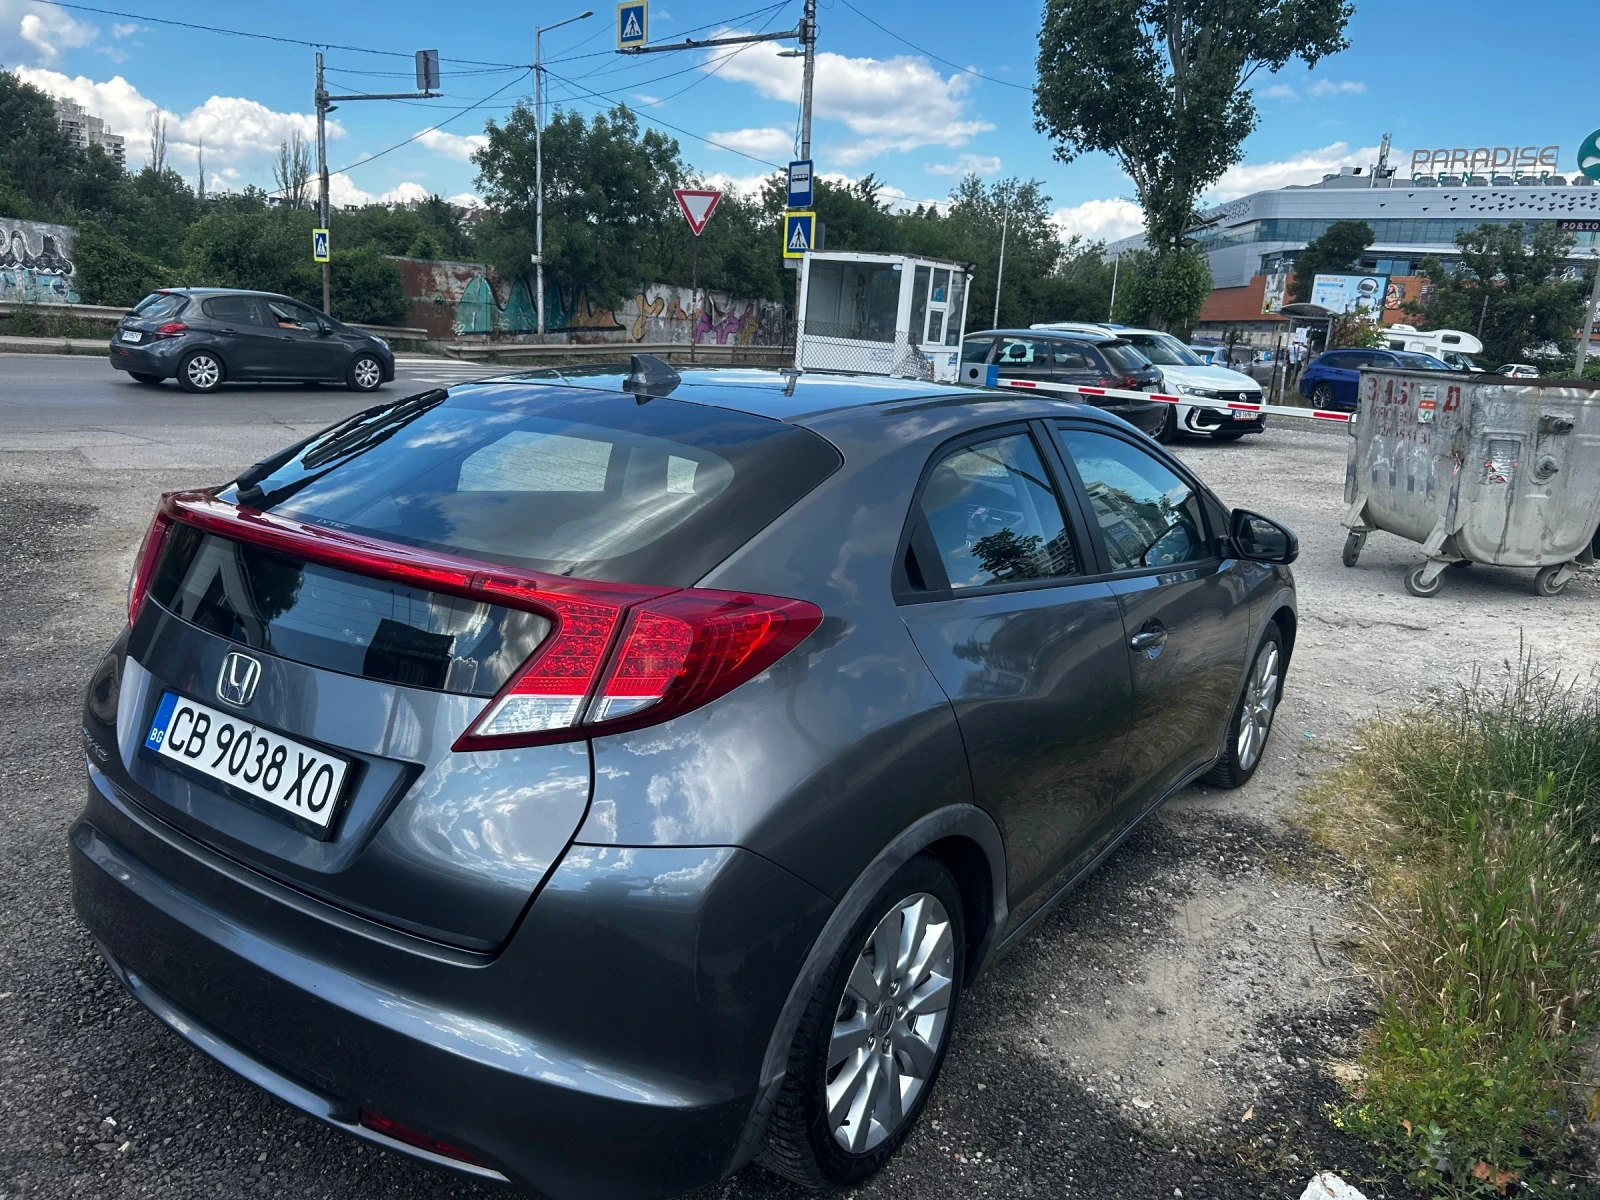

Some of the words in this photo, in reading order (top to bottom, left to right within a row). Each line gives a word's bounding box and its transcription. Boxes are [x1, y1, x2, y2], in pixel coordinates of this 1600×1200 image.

[1411, 146, 1559, 169] PARADISE
[1412, 170, 1550, 183] CENTER
[1562, 222, 1600, 230] PORTO
[150, 728, 164, 743] BG
[168, 706, 211, 759] CB
[211, 723, 288, 792] 9038
[283, 752, 334, 813] XO
